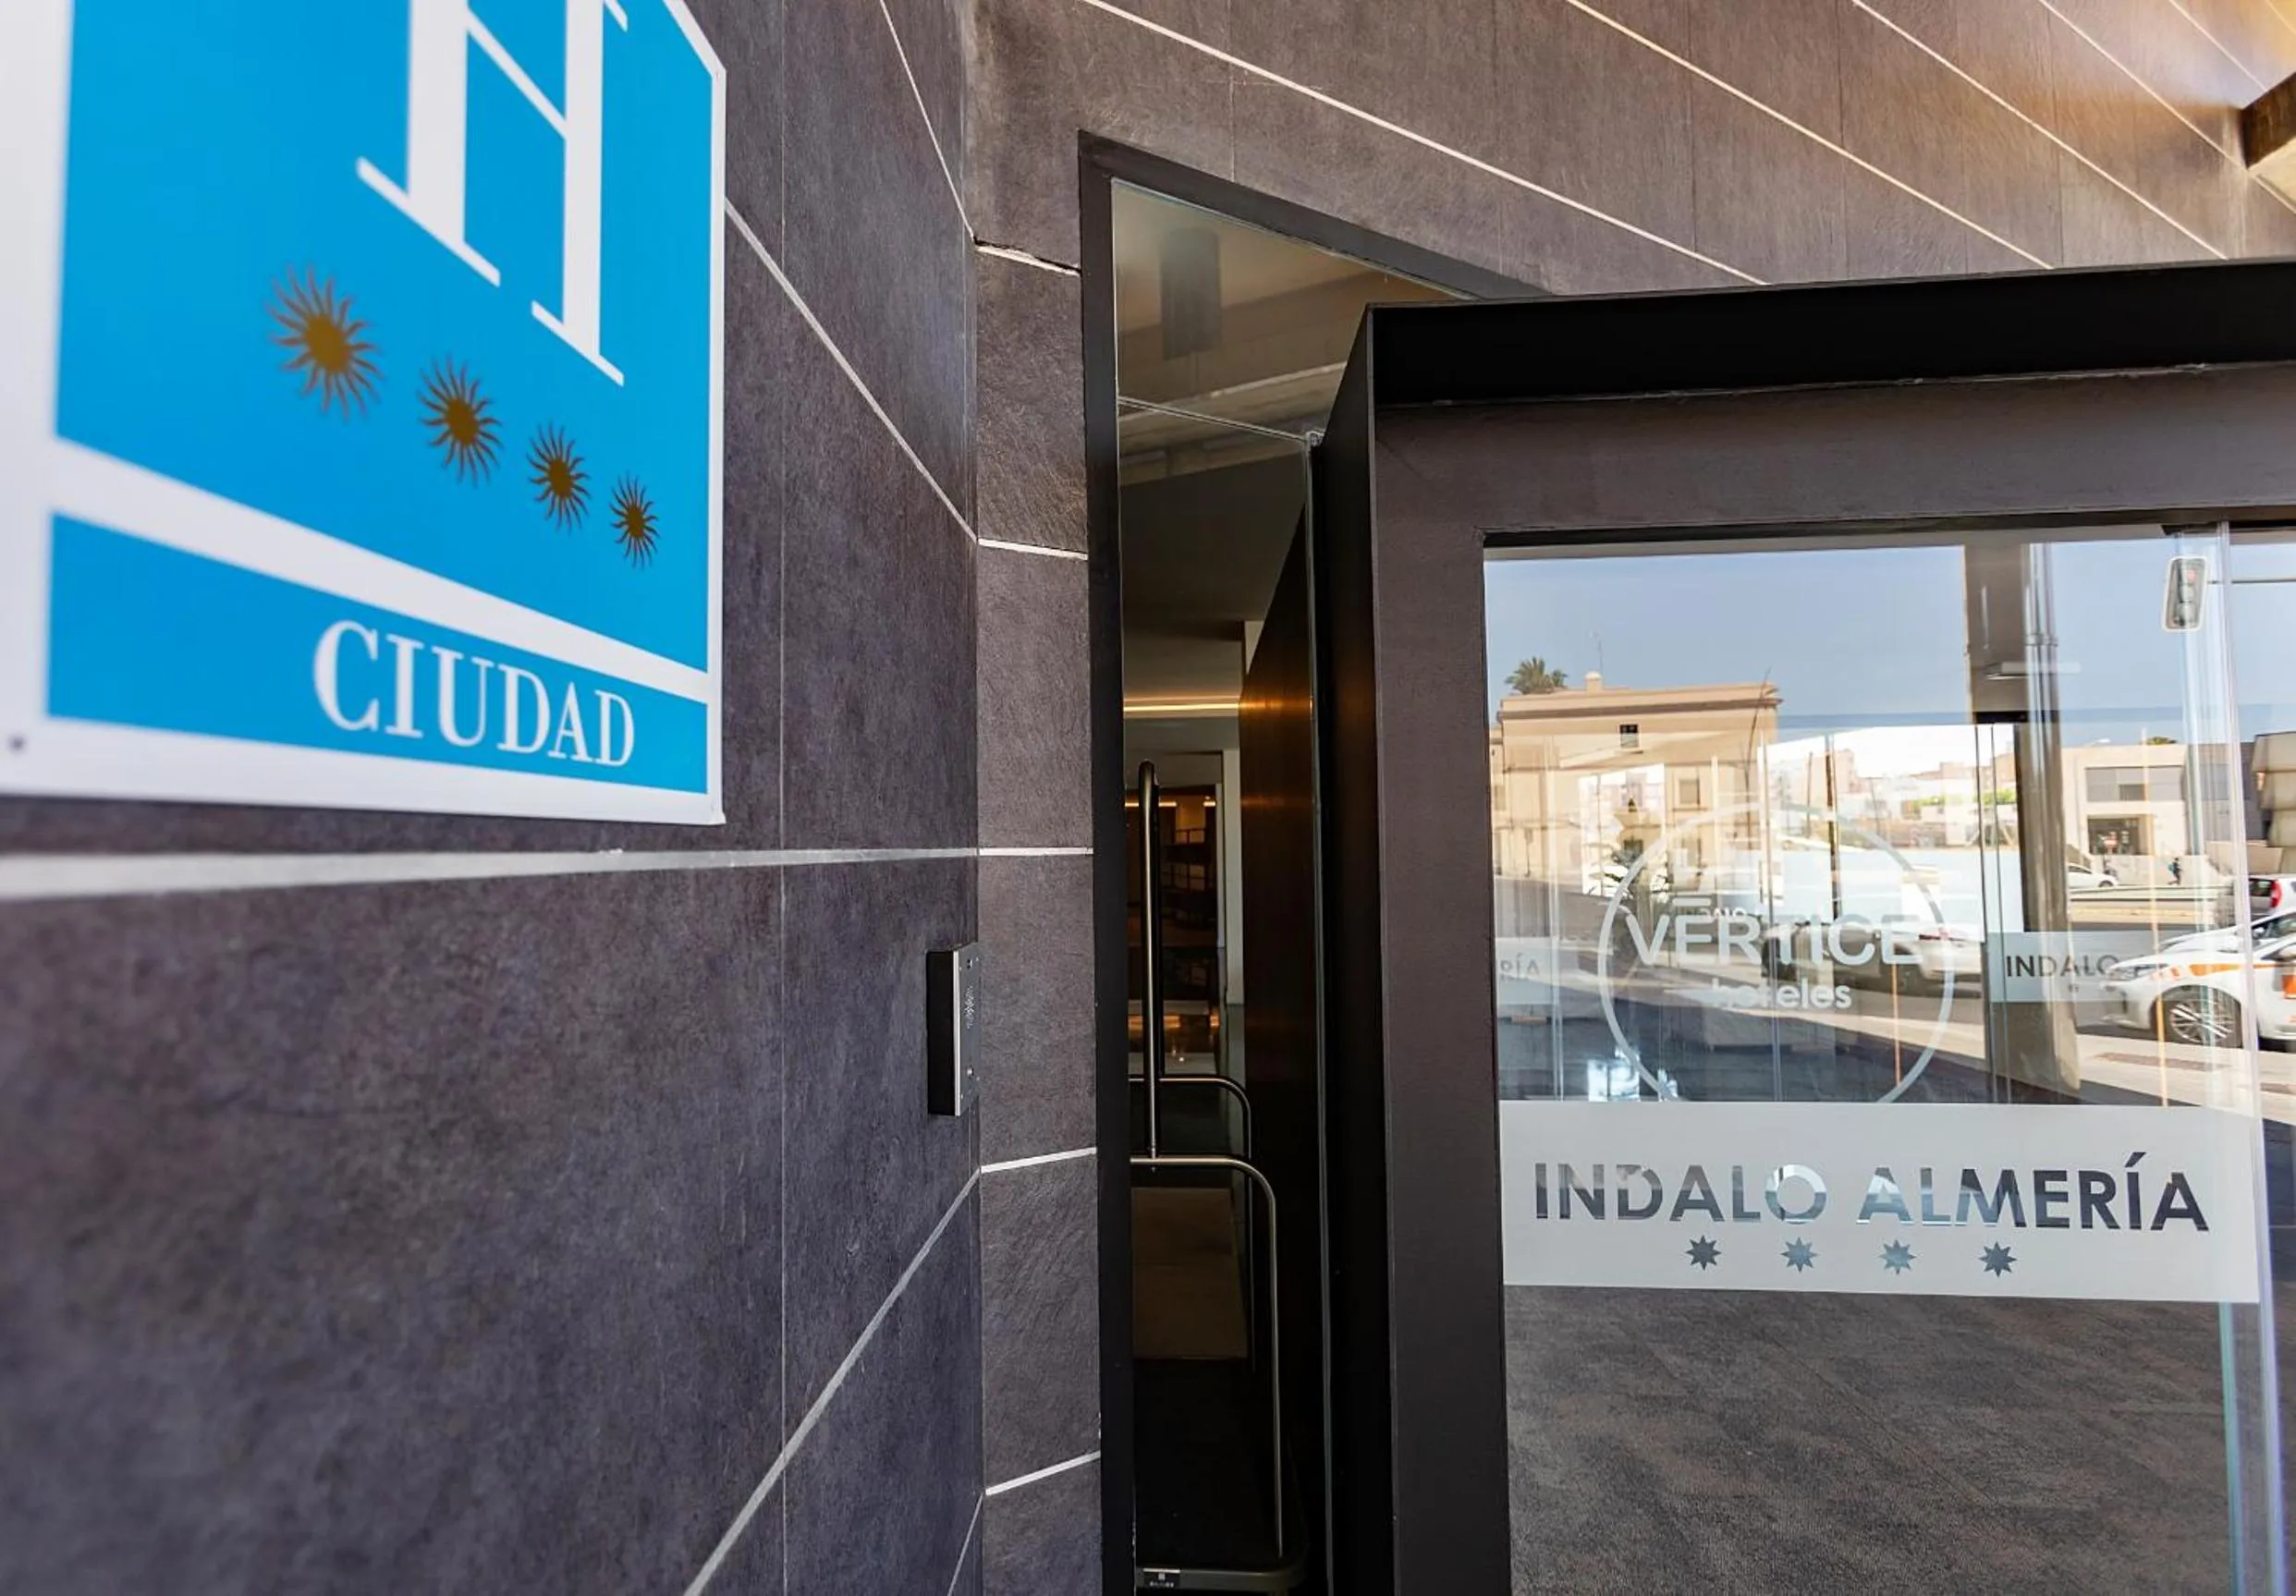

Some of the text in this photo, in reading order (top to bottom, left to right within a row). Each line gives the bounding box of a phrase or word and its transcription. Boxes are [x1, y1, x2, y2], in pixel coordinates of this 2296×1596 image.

[313, 620, 634, 767] CIUDAD
[1710, 978, 1852, 1009] hoteles
[1535, 1151, 2209, 1232] INDALO ALMERÍA
